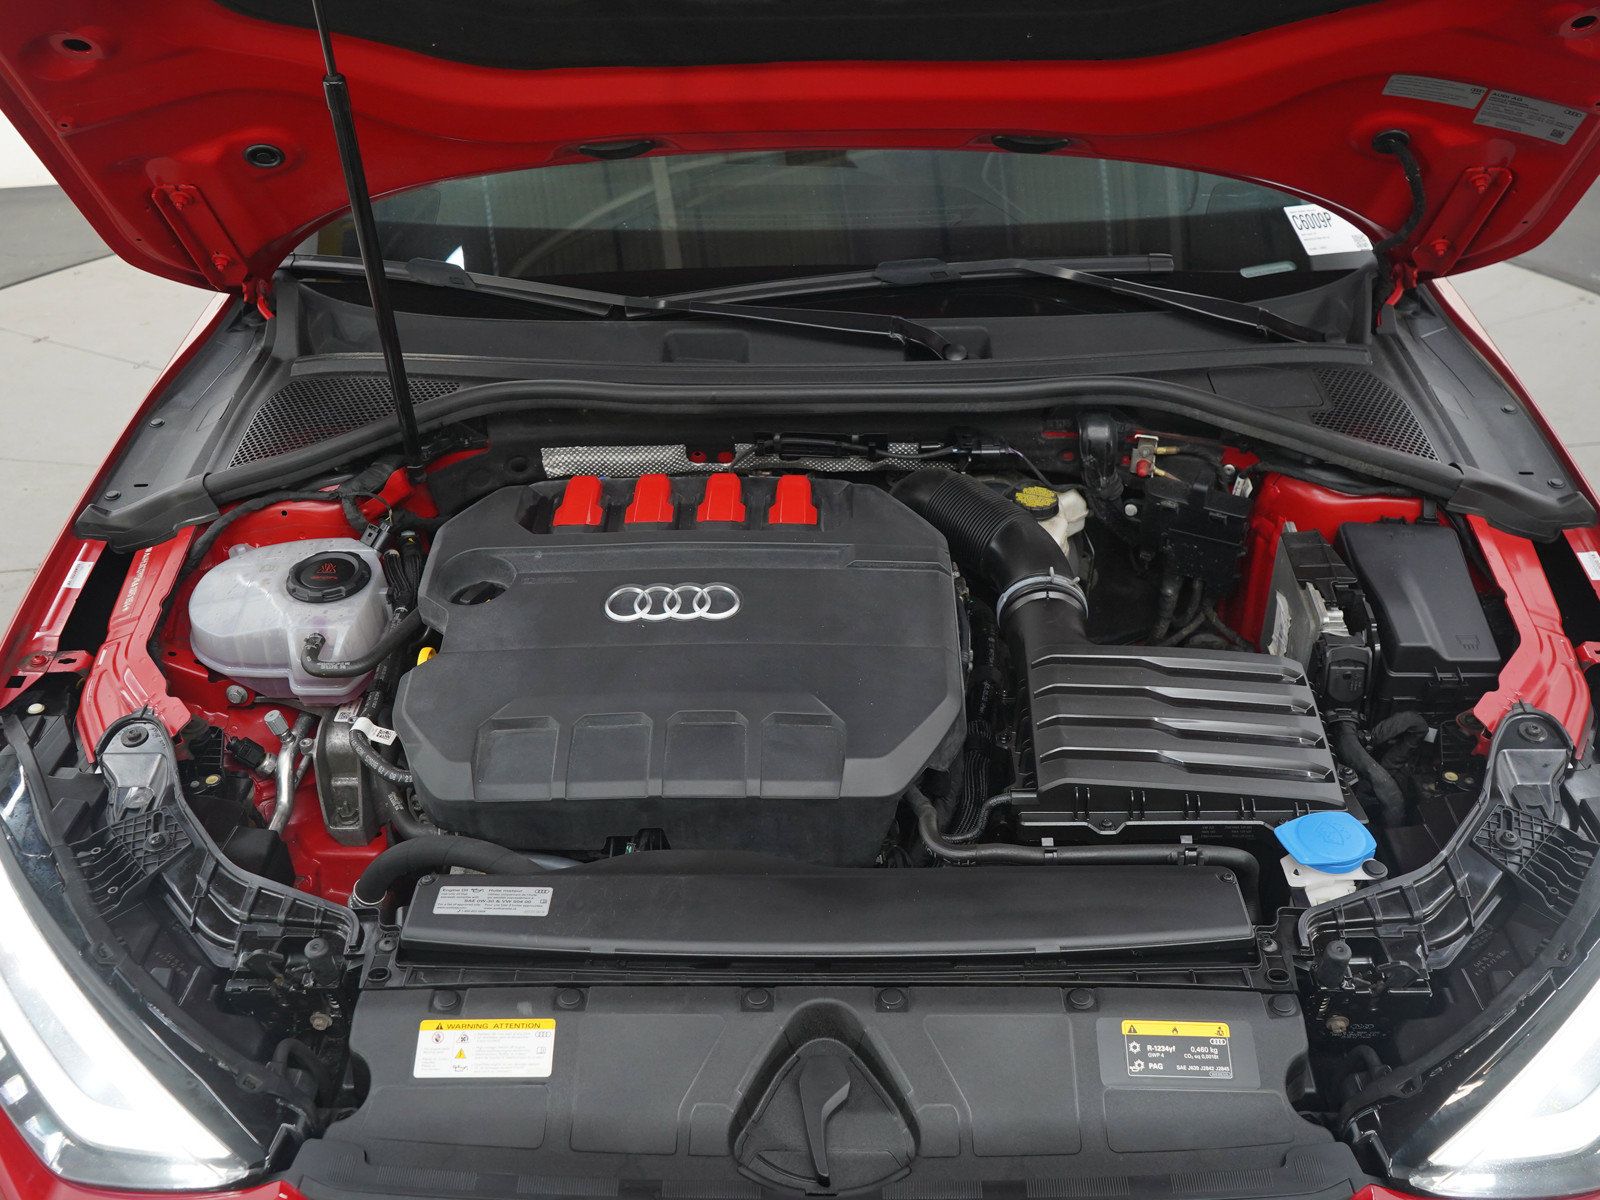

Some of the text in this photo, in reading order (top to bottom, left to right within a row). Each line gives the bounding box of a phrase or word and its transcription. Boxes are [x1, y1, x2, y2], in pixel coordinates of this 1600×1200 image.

[1292, 212, 1332, 231] C6009P
[1146, 1044, 1176, 1053] R-1234yf
[1209, 1046, 1218, 1054] kg
[1148, 1062, 1164, 1070] PAG
